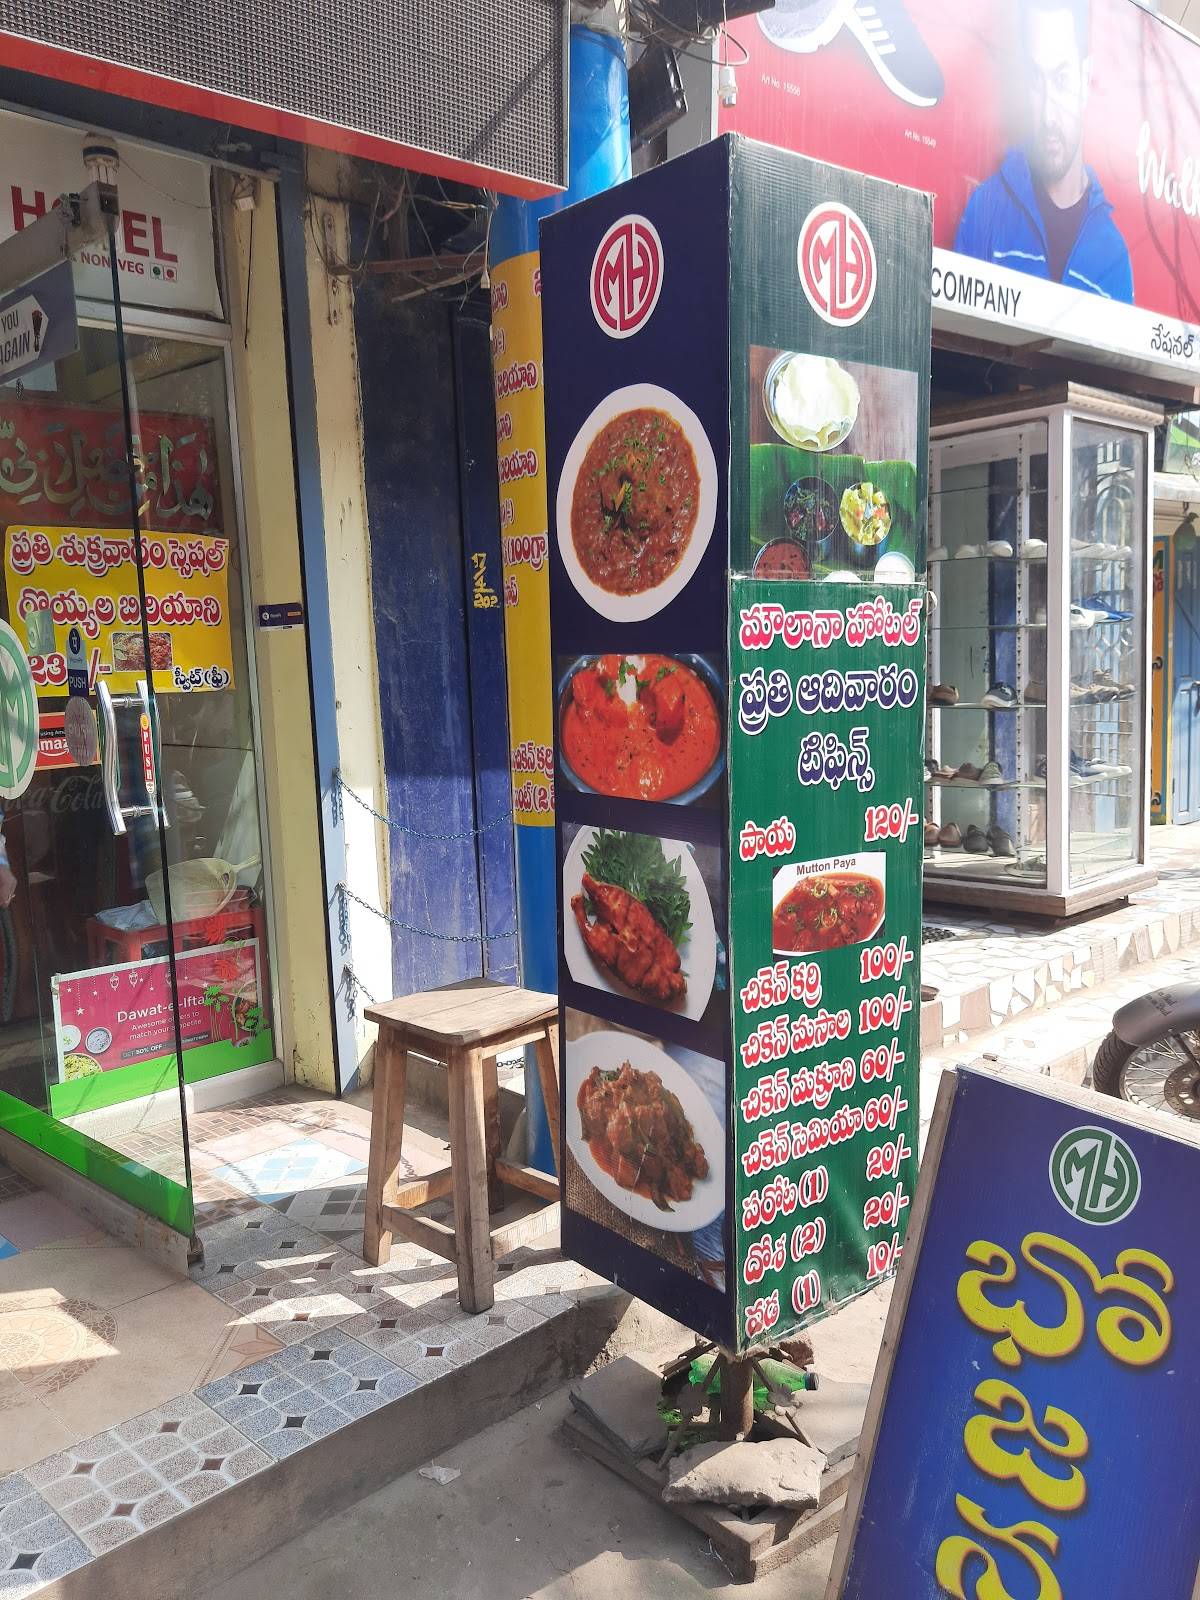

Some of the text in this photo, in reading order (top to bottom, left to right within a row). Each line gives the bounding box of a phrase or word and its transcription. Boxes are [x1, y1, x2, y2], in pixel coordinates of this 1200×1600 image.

[11, 186, 178, 263] HEL
[10, 530, 53, 574] ప్రతి
[69, 676, 87, 689] PUSH
[739, 663, 918, 735] ప్రతి ఆదివారం
[143, 731, 153, 780] PUSH
[739, 798, 919, 860] పాయ 120/-
[796, 857, 856, 876] Mutton Paya
[117, 994, 209, 1023] Dawat-e-Ifta
[740, 960, 791, 1013] చికెన్
[860, 935, 914, 983] 100/-
[129, 1029, 152, 1041] match
[153, 1026, 170, 1037] your
[131, 1017, 168, 1031] Awesome
[168, 1012, 192, 1023] oers
[741, 986, 912, 1068] చికెన్ మసాల 100/-
[741, 1068, 790, 1123] చికెన్
[860, 1037, 905, 1082] 60/-
[742, 1121, 791, 1177] చికెన్
[863, 1085, 908, 1131] 60/-
[799, 1165, 829, 1208] (1)
[867, 1134, 912, 1181] 20/-
[791, 1216, 826, 1262] (2)
[864, 1182, 909, 1230] 20/-
[792, 1269, 821, 1314] (1)
[866, 1231, 903, 1280] 10/-
